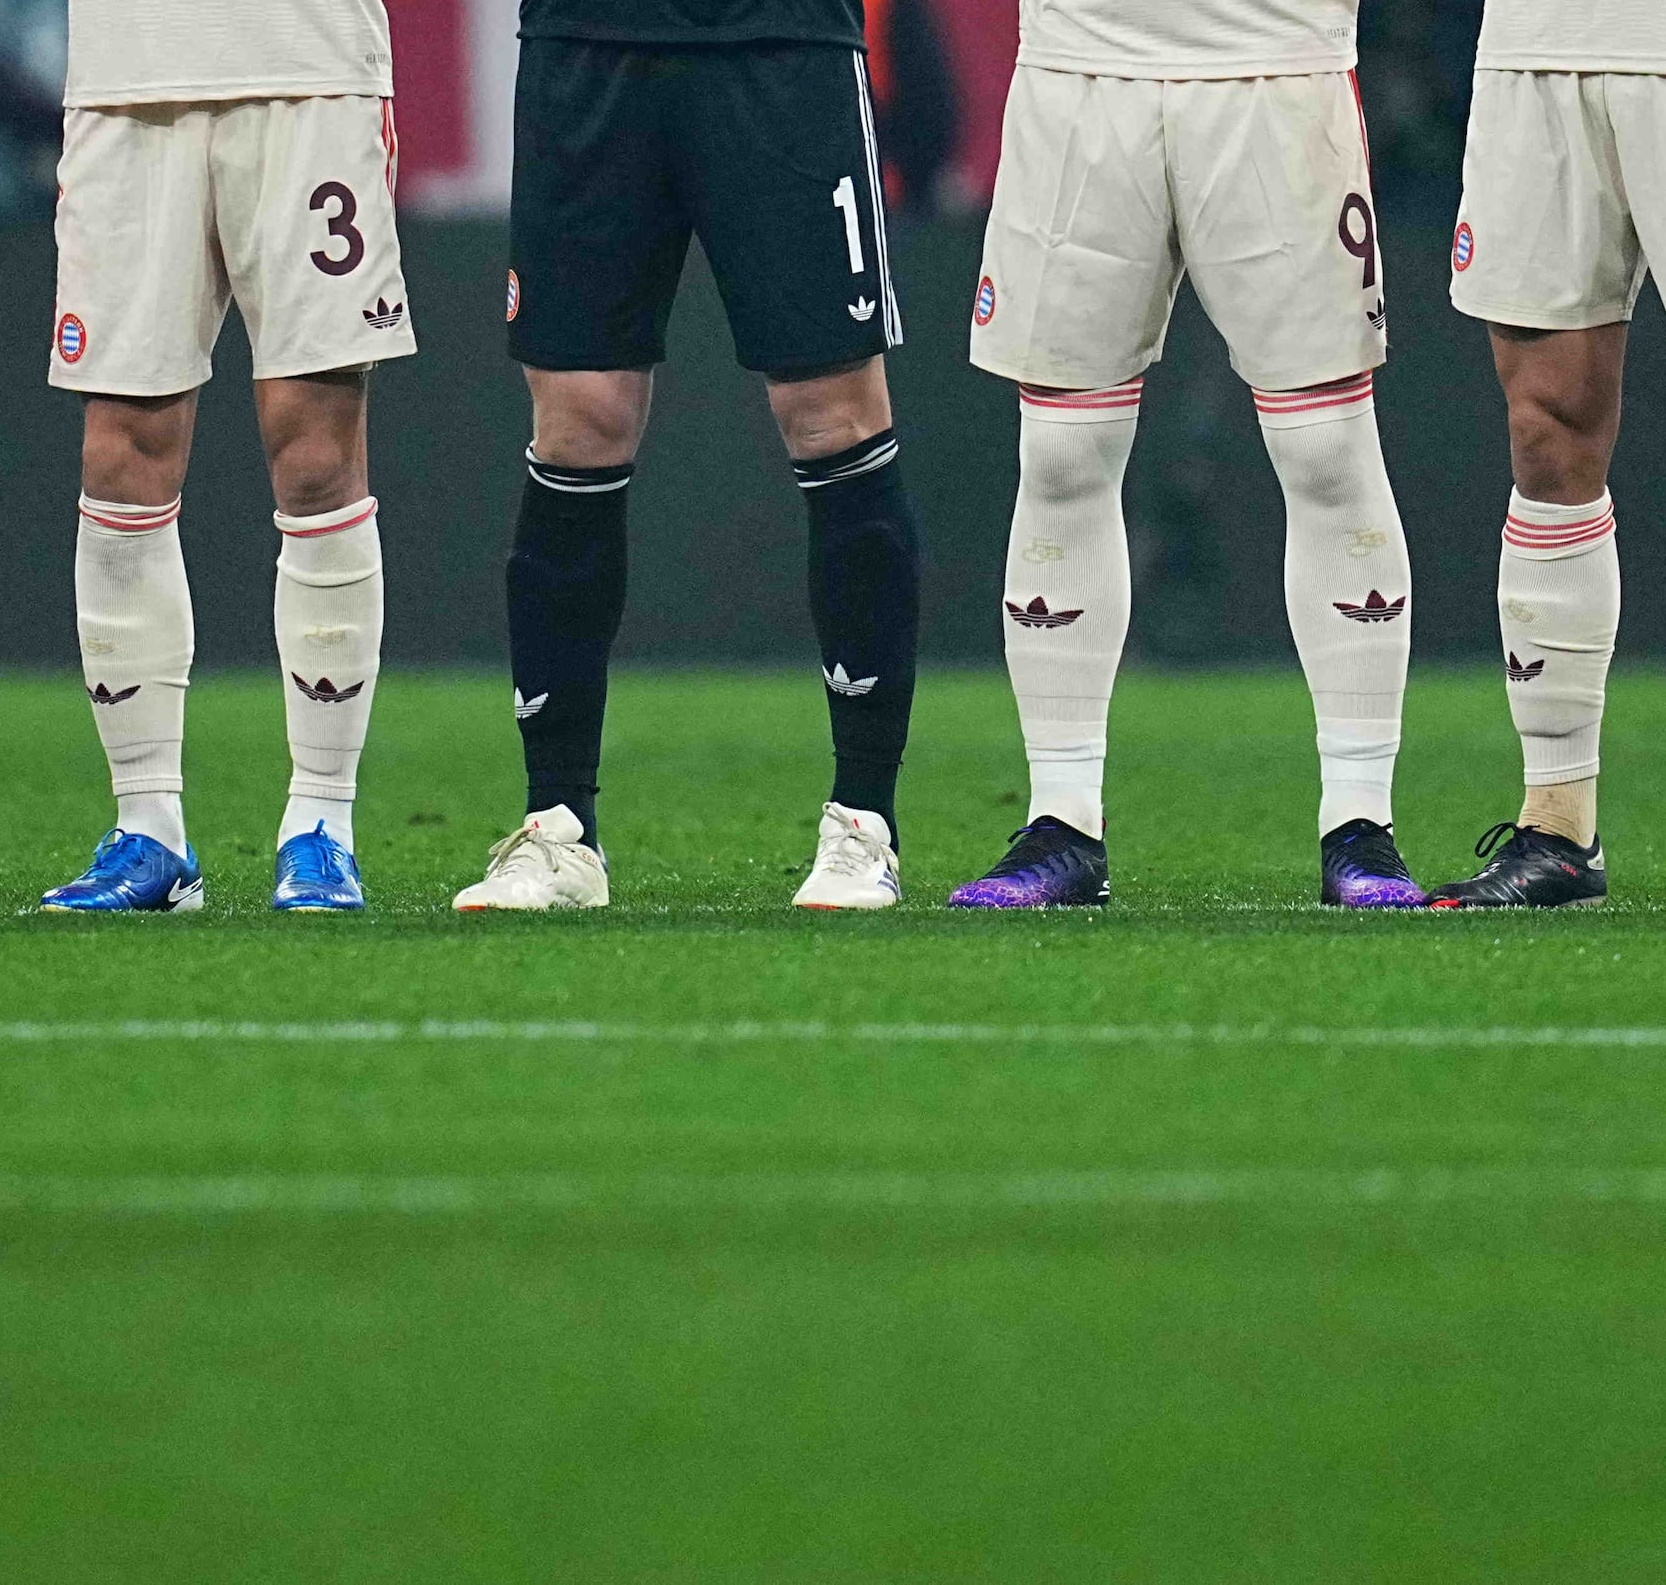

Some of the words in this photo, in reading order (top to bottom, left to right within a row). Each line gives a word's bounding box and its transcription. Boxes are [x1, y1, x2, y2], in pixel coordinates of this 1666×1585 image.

[309, 181, 365, 276] 3
[833, 176, 864, 274] 1
[1339, 193, 1375, 289] 9
